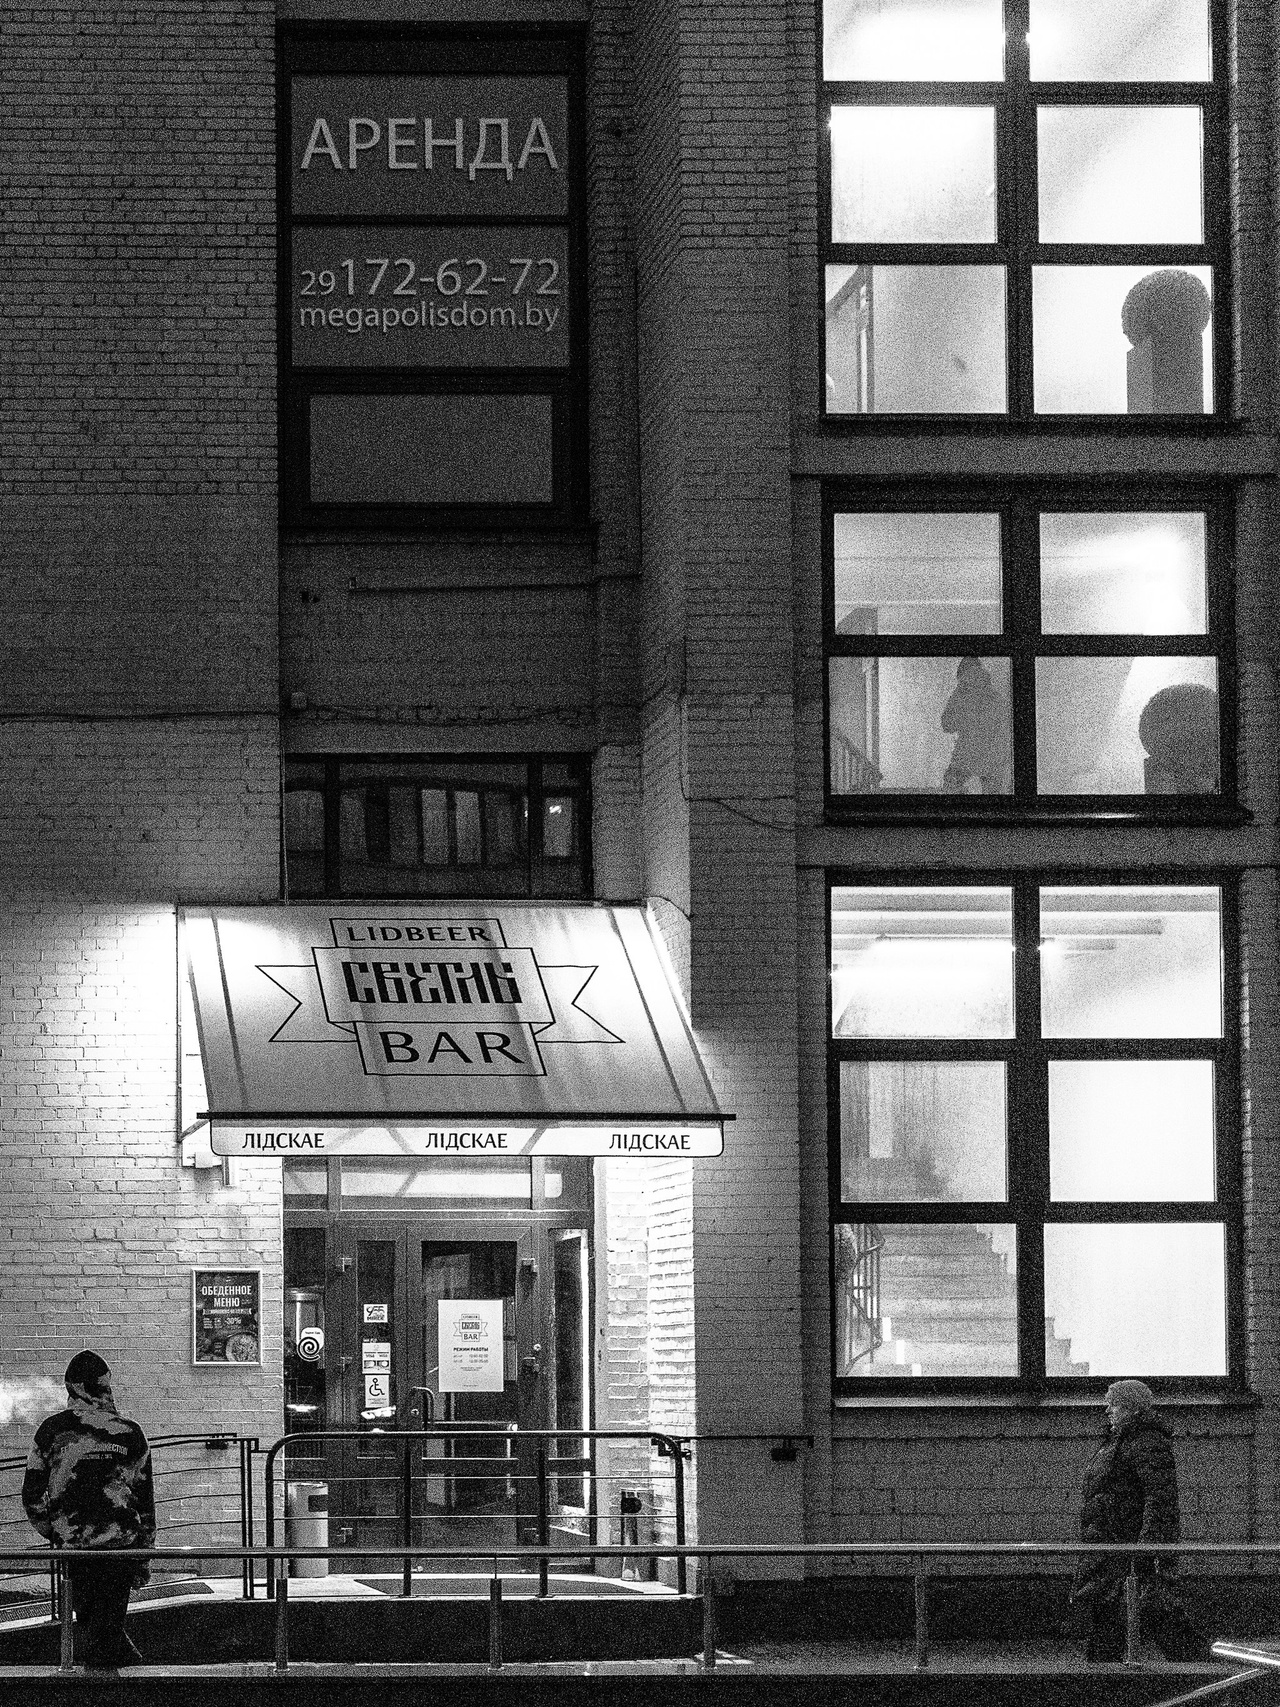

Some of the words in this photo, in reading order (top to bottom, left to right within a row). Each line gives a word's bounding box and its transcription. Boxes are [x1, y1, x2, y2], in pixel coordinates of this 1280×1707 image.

[300, 117, 559, 181] АРЕНДА
[299, 301, 559, 333] megapolisdom.by
[347, 926, 492, 942] LIDBEER
[378, 1031, 526, 1064] BAR
[241, 1132, 325, 1151] ЛІДСКАЕ
[425, 1132, 508, 1151] ЛІДСКАЕ
[609, 1133, 692, 1152] ЛІДСКАЕ
[201, 1285, 252, 1297] ОБЕДЕННОЕ
[213, 1297, 240, 1307] МЕНЮ
